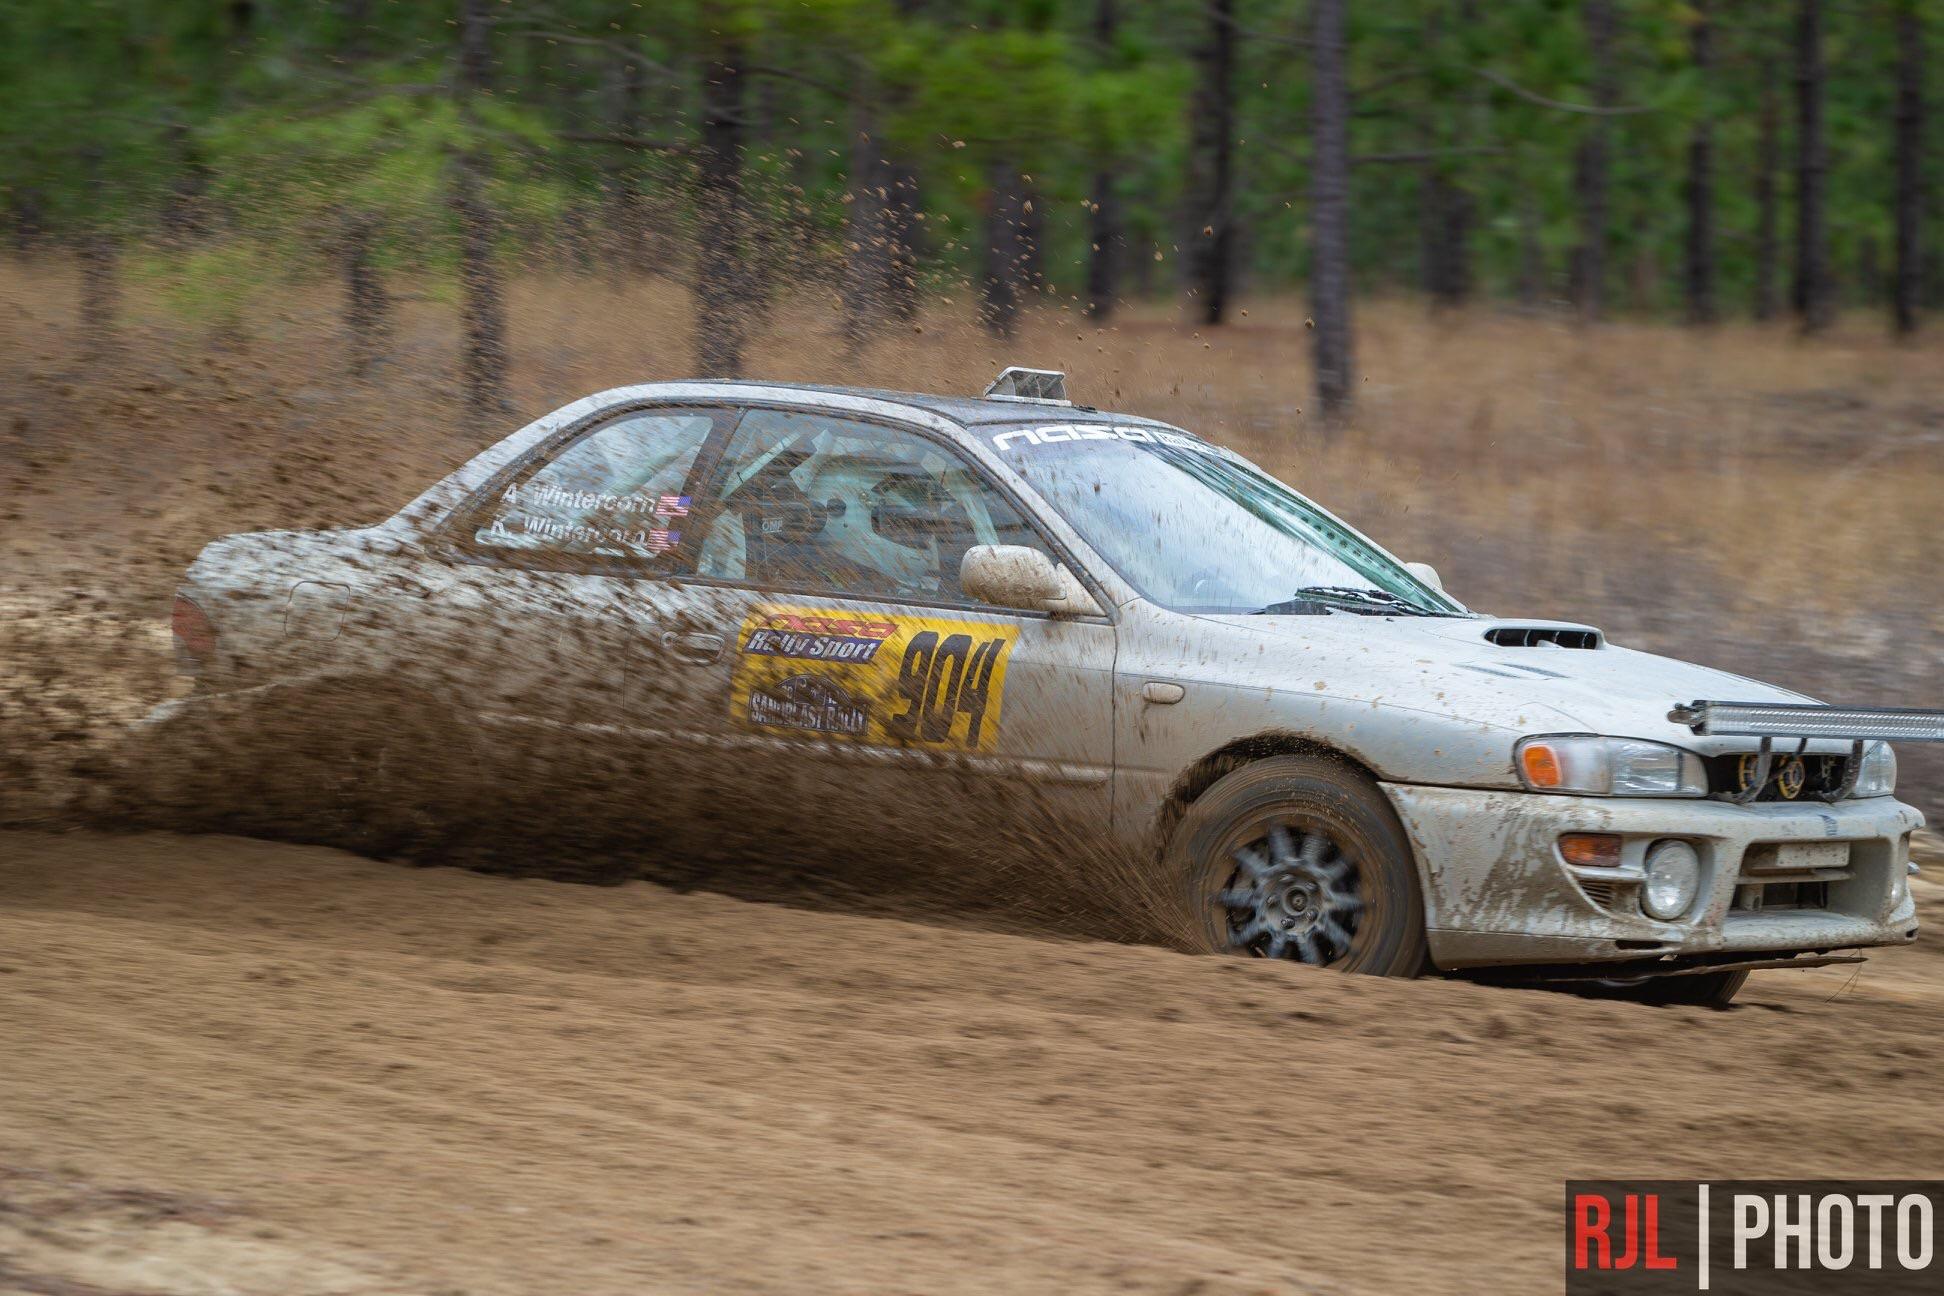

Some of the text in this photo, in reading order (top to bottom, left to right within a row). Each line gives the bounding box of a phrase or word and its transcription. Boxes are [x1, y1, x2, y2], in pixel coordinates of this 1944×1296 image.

[534, 483, 655, 513] Wintercorn
[749, 631, 877, 660] Rally Sport
[892, 631, 1006, 748] 904
